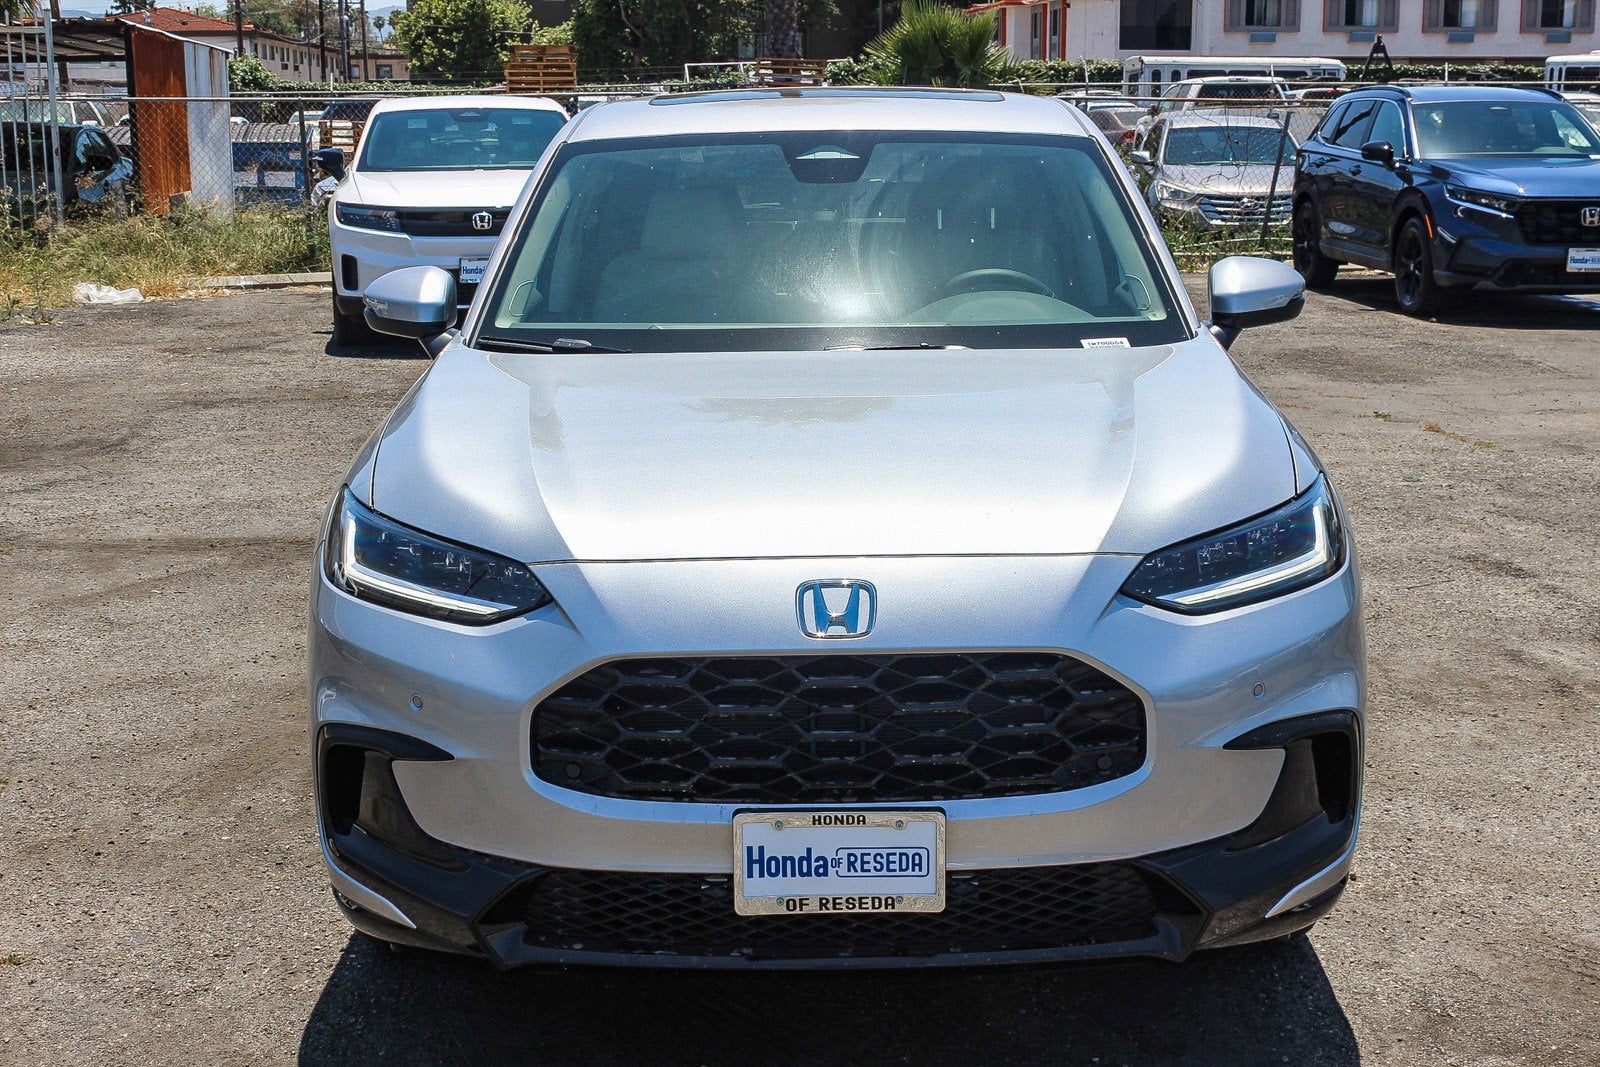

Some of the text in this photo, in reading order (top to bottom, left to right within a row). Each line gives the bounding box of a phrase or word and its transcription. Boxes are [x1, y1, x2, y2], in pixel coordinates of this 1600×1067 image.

[462, 266, 483, 275] Honda
[811, 814, 867, 826] HONDA
[746, 845, 923, 878] Honda OF RESEDA
[785, 896, 896, 912] OF RESEDA
